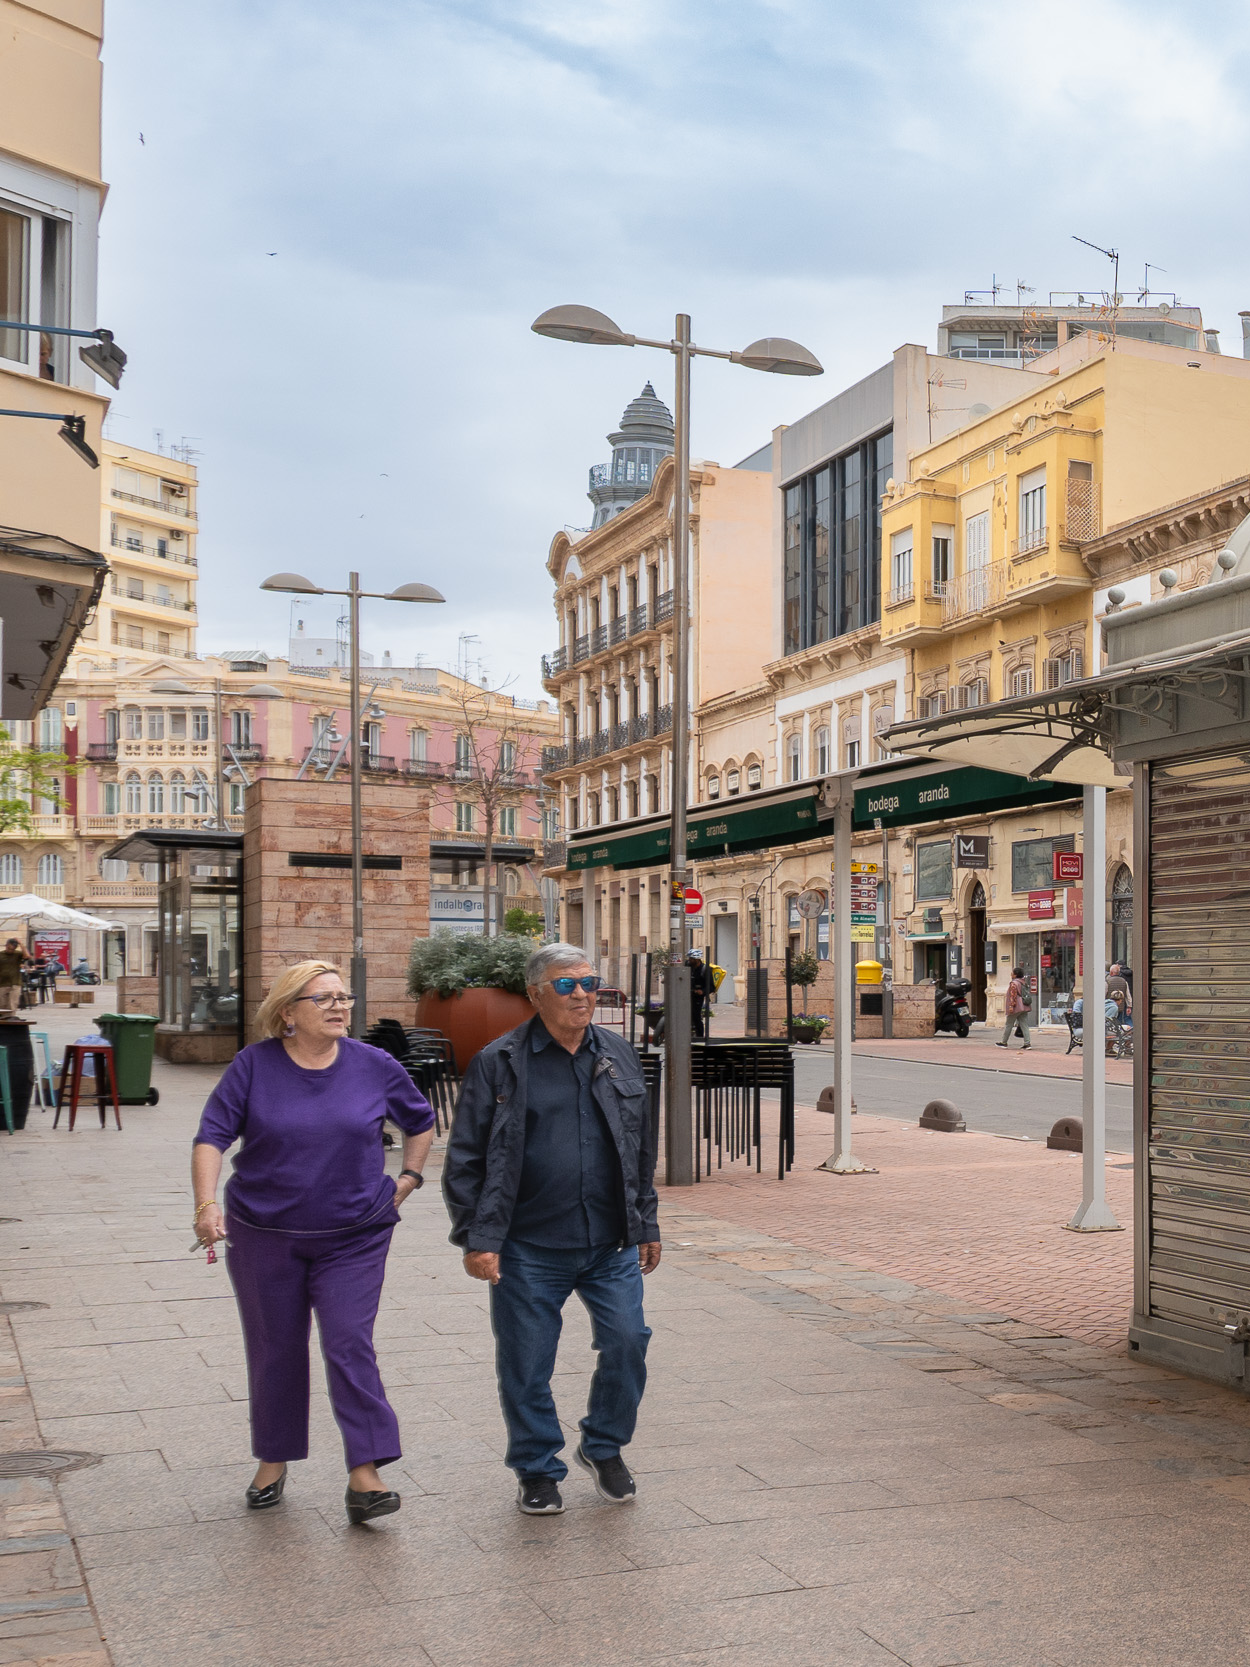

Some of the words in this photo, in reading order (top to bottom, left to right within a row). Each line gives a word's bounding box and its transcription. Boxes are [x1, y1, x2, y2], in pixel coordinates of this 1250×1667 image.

[868, 795, 900, 813] bodega
[918, 783, 950, 804] aranda
[706, 821, 728, 837] aranda
